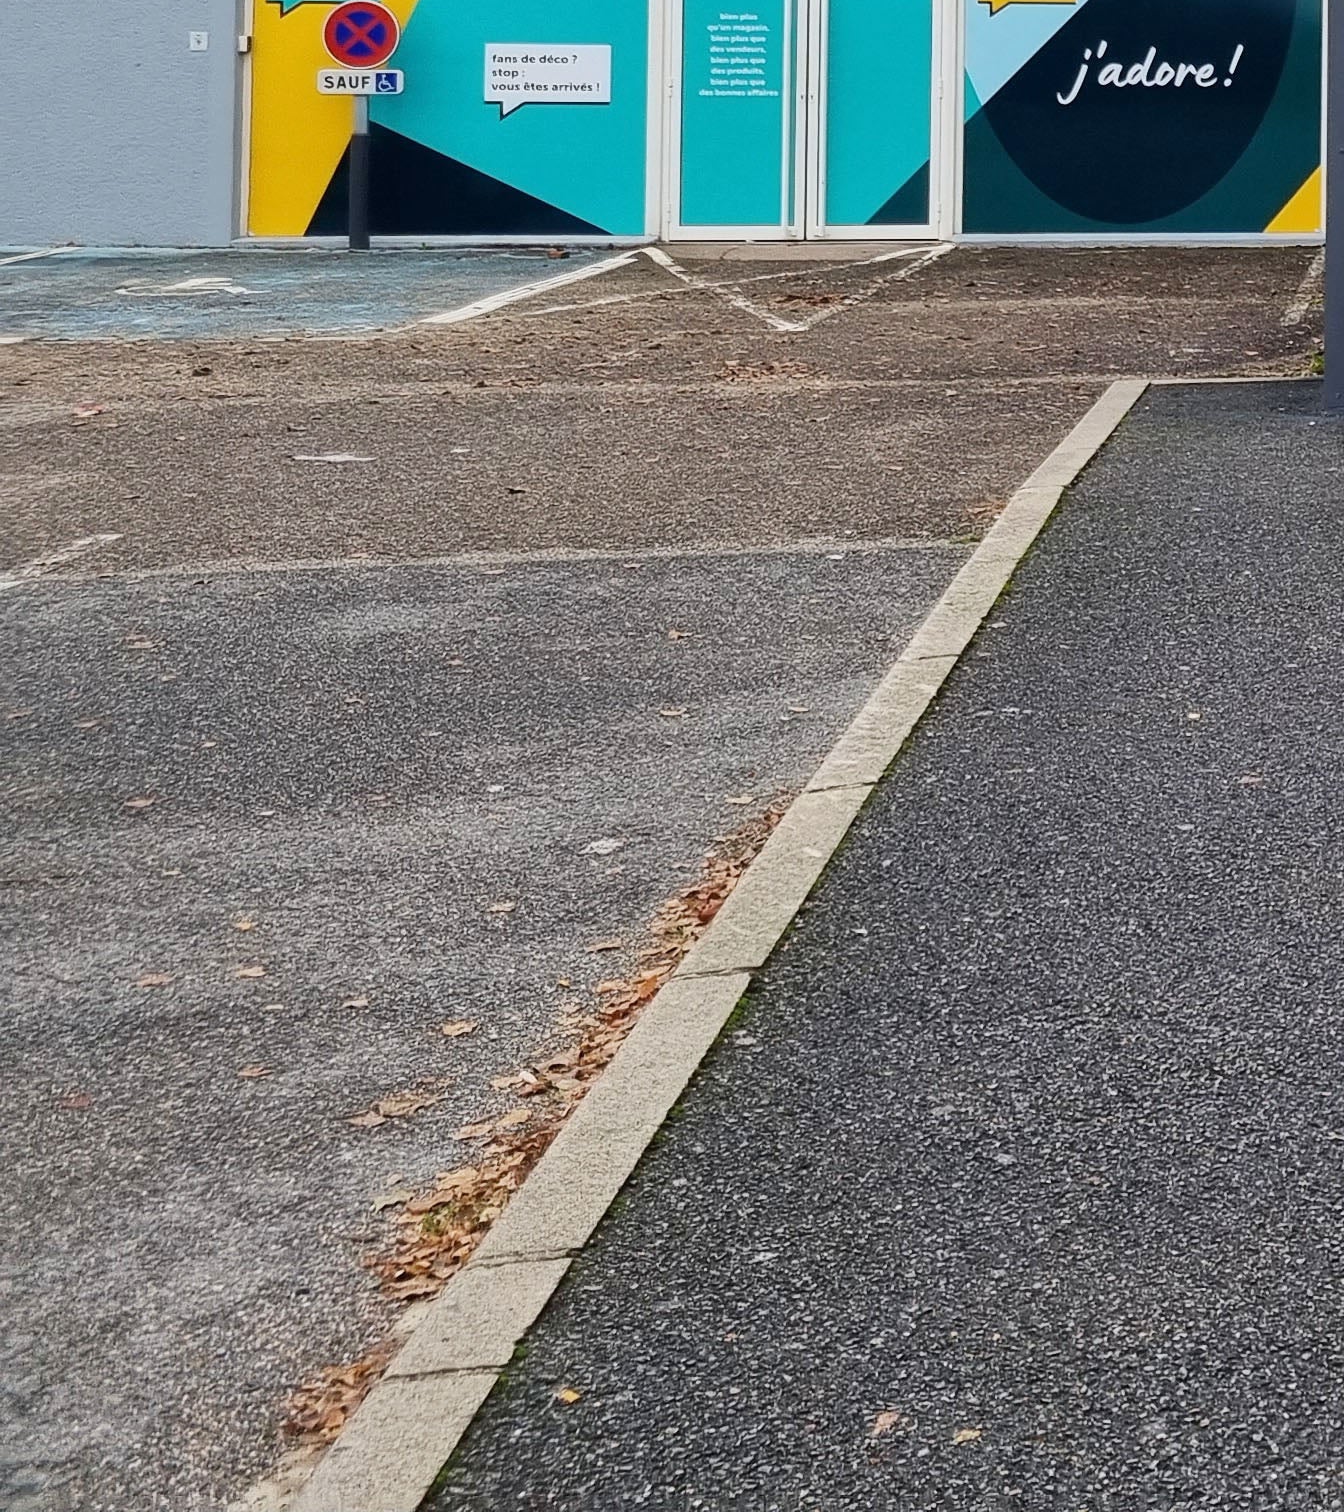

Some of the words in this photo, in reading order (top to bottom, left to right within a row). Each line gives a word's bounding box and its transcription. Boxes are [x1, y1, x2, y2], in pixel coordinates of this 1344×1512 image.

[740, 13, 758, 21] plus
[730, 35, 749, 43] plus
[492, 54, 517, 63] fans
[521, 54, 536, 64] de
[539, 54, 568, 64] déco
[730, 56, 748, 64] plus
[491, 69, 519, 79] stop
[323, 75, 371, 90] SAUF
[730, 78, 748, 86] plus
[491, 83, 520, 91] vous
[523, 82, 549, 91] êtes
[551, 82, 593, 92] arrivés
